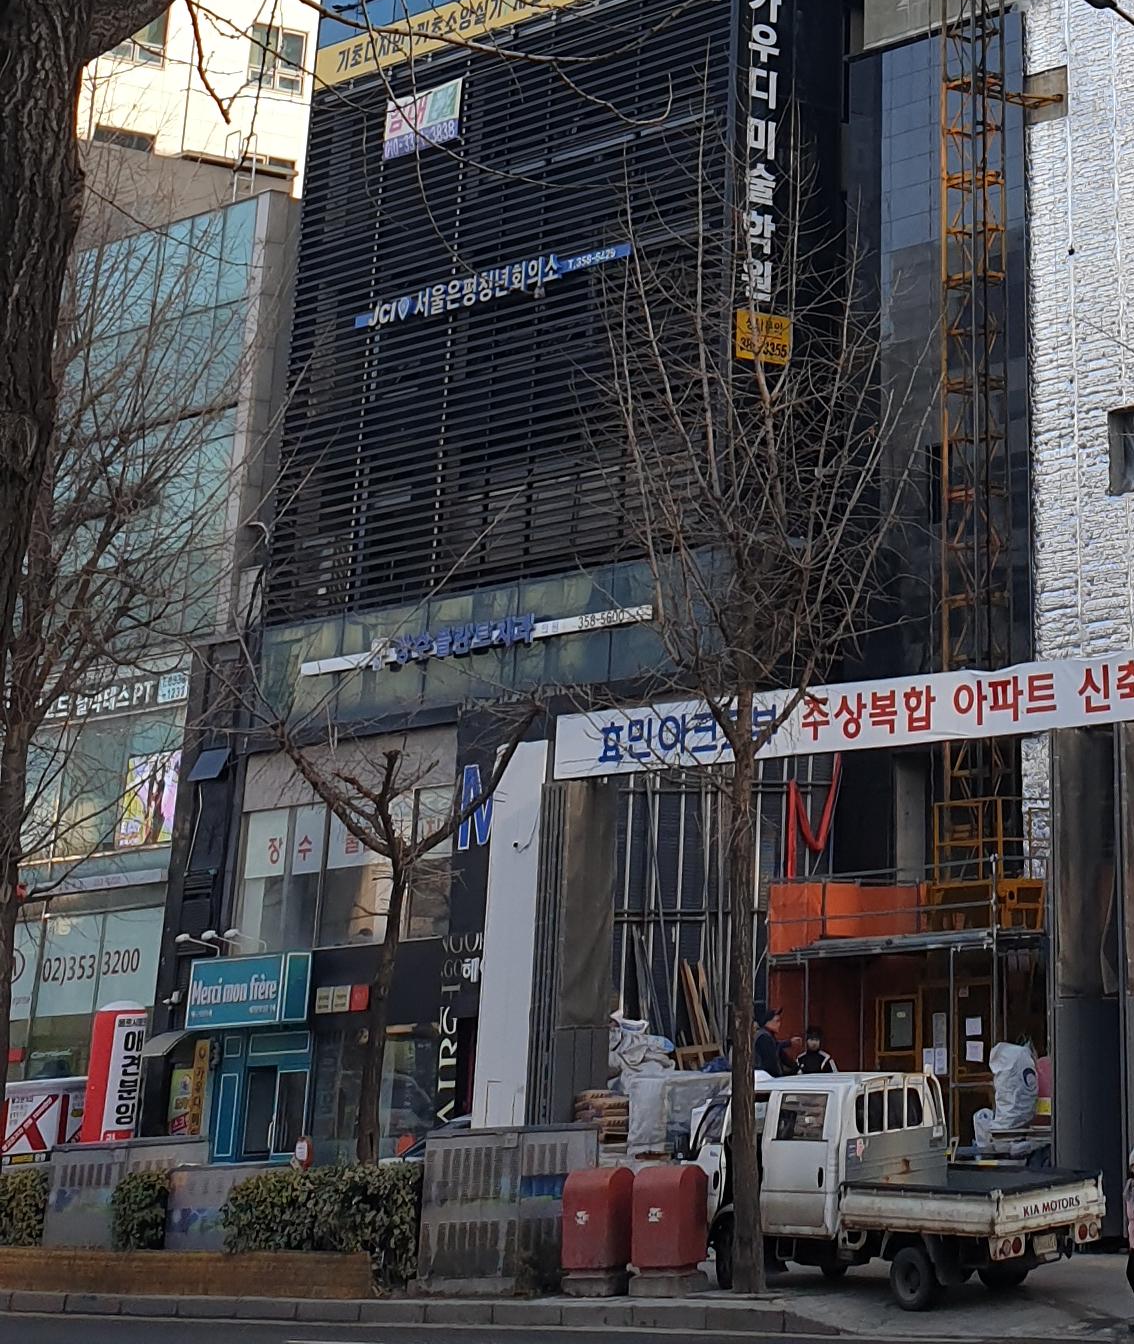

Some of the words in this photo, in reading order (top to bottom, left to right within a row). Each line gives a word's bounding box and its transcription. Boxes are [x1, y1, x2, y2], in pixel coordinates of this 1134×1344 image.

[414, 253, 560, 318] 서울은평청년회의소
[367, 300, 397, 327] JCI
[801, 684, 936, 742] 주상복합
[953, 673, 1058, 726] 아파트
[191, 977, 222, 1006] Merci
[223, 983, 247, 1003] mon
[249, 973, 277, 1001] frère
[1023, 1202, 1040, 1218] KIA
[1042, 1195, 1081, 1212] MOTORS
